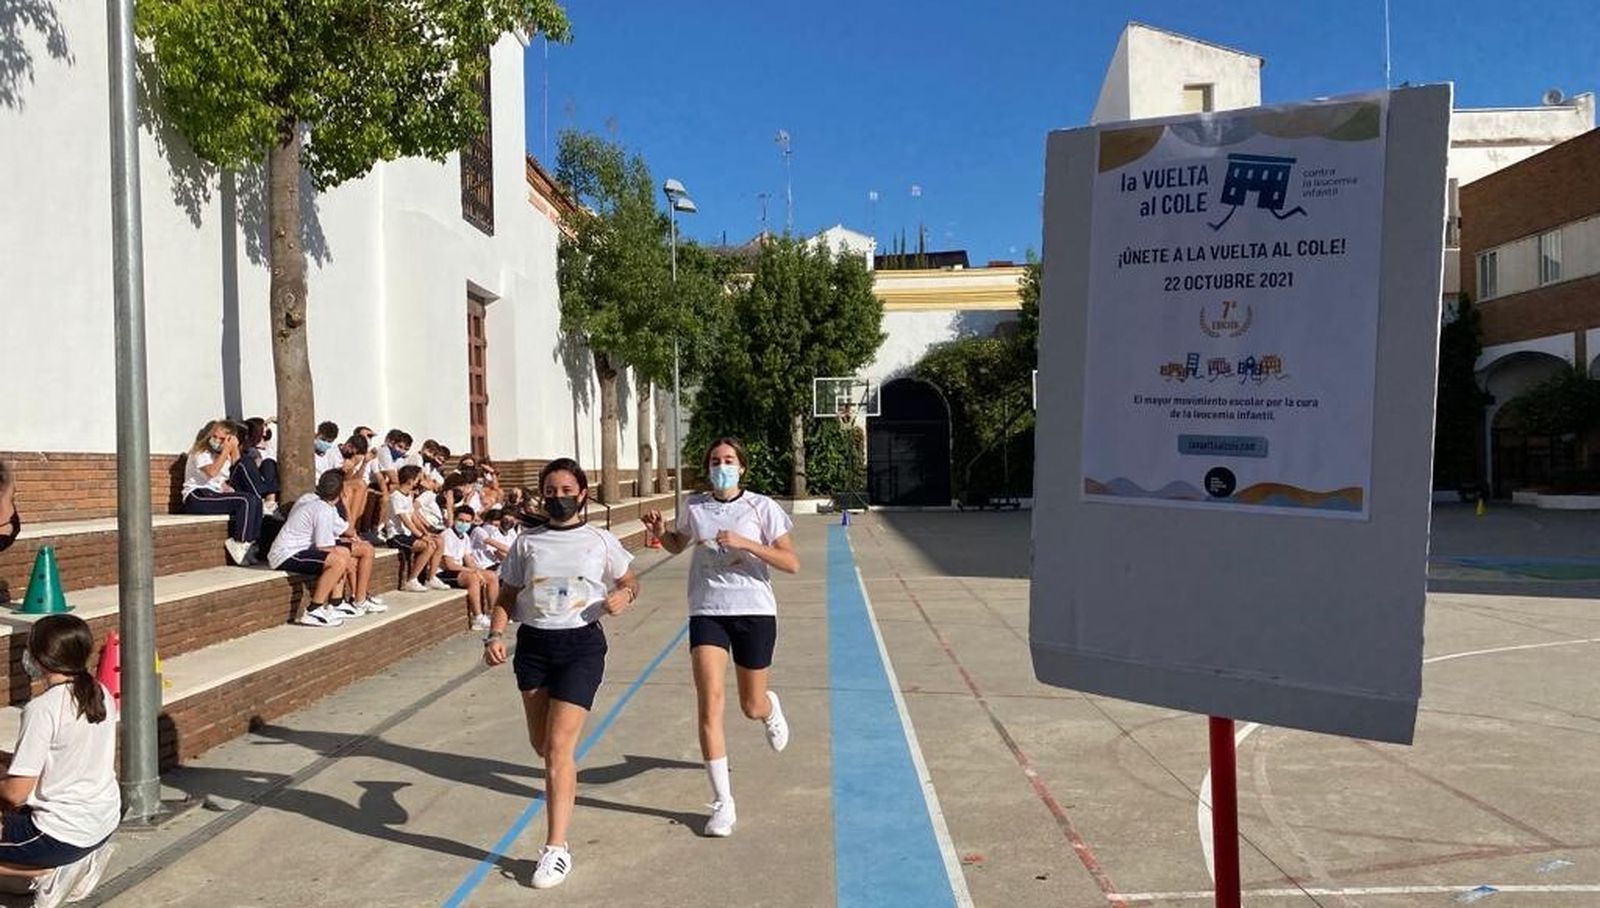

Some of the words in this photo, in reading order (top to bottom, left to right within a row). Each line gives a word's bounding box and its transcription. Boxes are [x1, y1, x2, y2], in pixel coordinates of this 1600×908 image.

[1121, 173, 1138, 192] la
[1142, 165, 1210, 190] VUELTA
[1303, 168, 1336, 178] contra
[1140, 199, 1157, 217] al
[1161, 192, 1209, 216] COLE
[1118, 246, 1170, 268] ¡ÚNETE
[1173, 247, 1184, 263] A
[1188, 246, 1206, 262] LA
[1210, 243, 1269, 261] VUELTA
[1272, 241, 1292, 258] AL
[1297, 238, 1347, 256] COLE!
[1164, 276, 1181, 292] 22
[1184, 273, 1256, 291] OCTUBRE
[1259, 271, 1294, 289] 2021
[1133, 395, 1143, 404] El
[1144, 396, 1172, 407] mayor
[1173, 396, 1228, 406] movimiento
[1229, 396, 1264, 407] escolar
[1266, 398, 1283, 408] por
[1285, 397, 1294, 407] la
[1296, 399, 1319, 408] cura
[1170, 408, 1181, 419] de
[1182, 409, 1192, 419] la
[1193, 409, 1235, 420] leucemia
